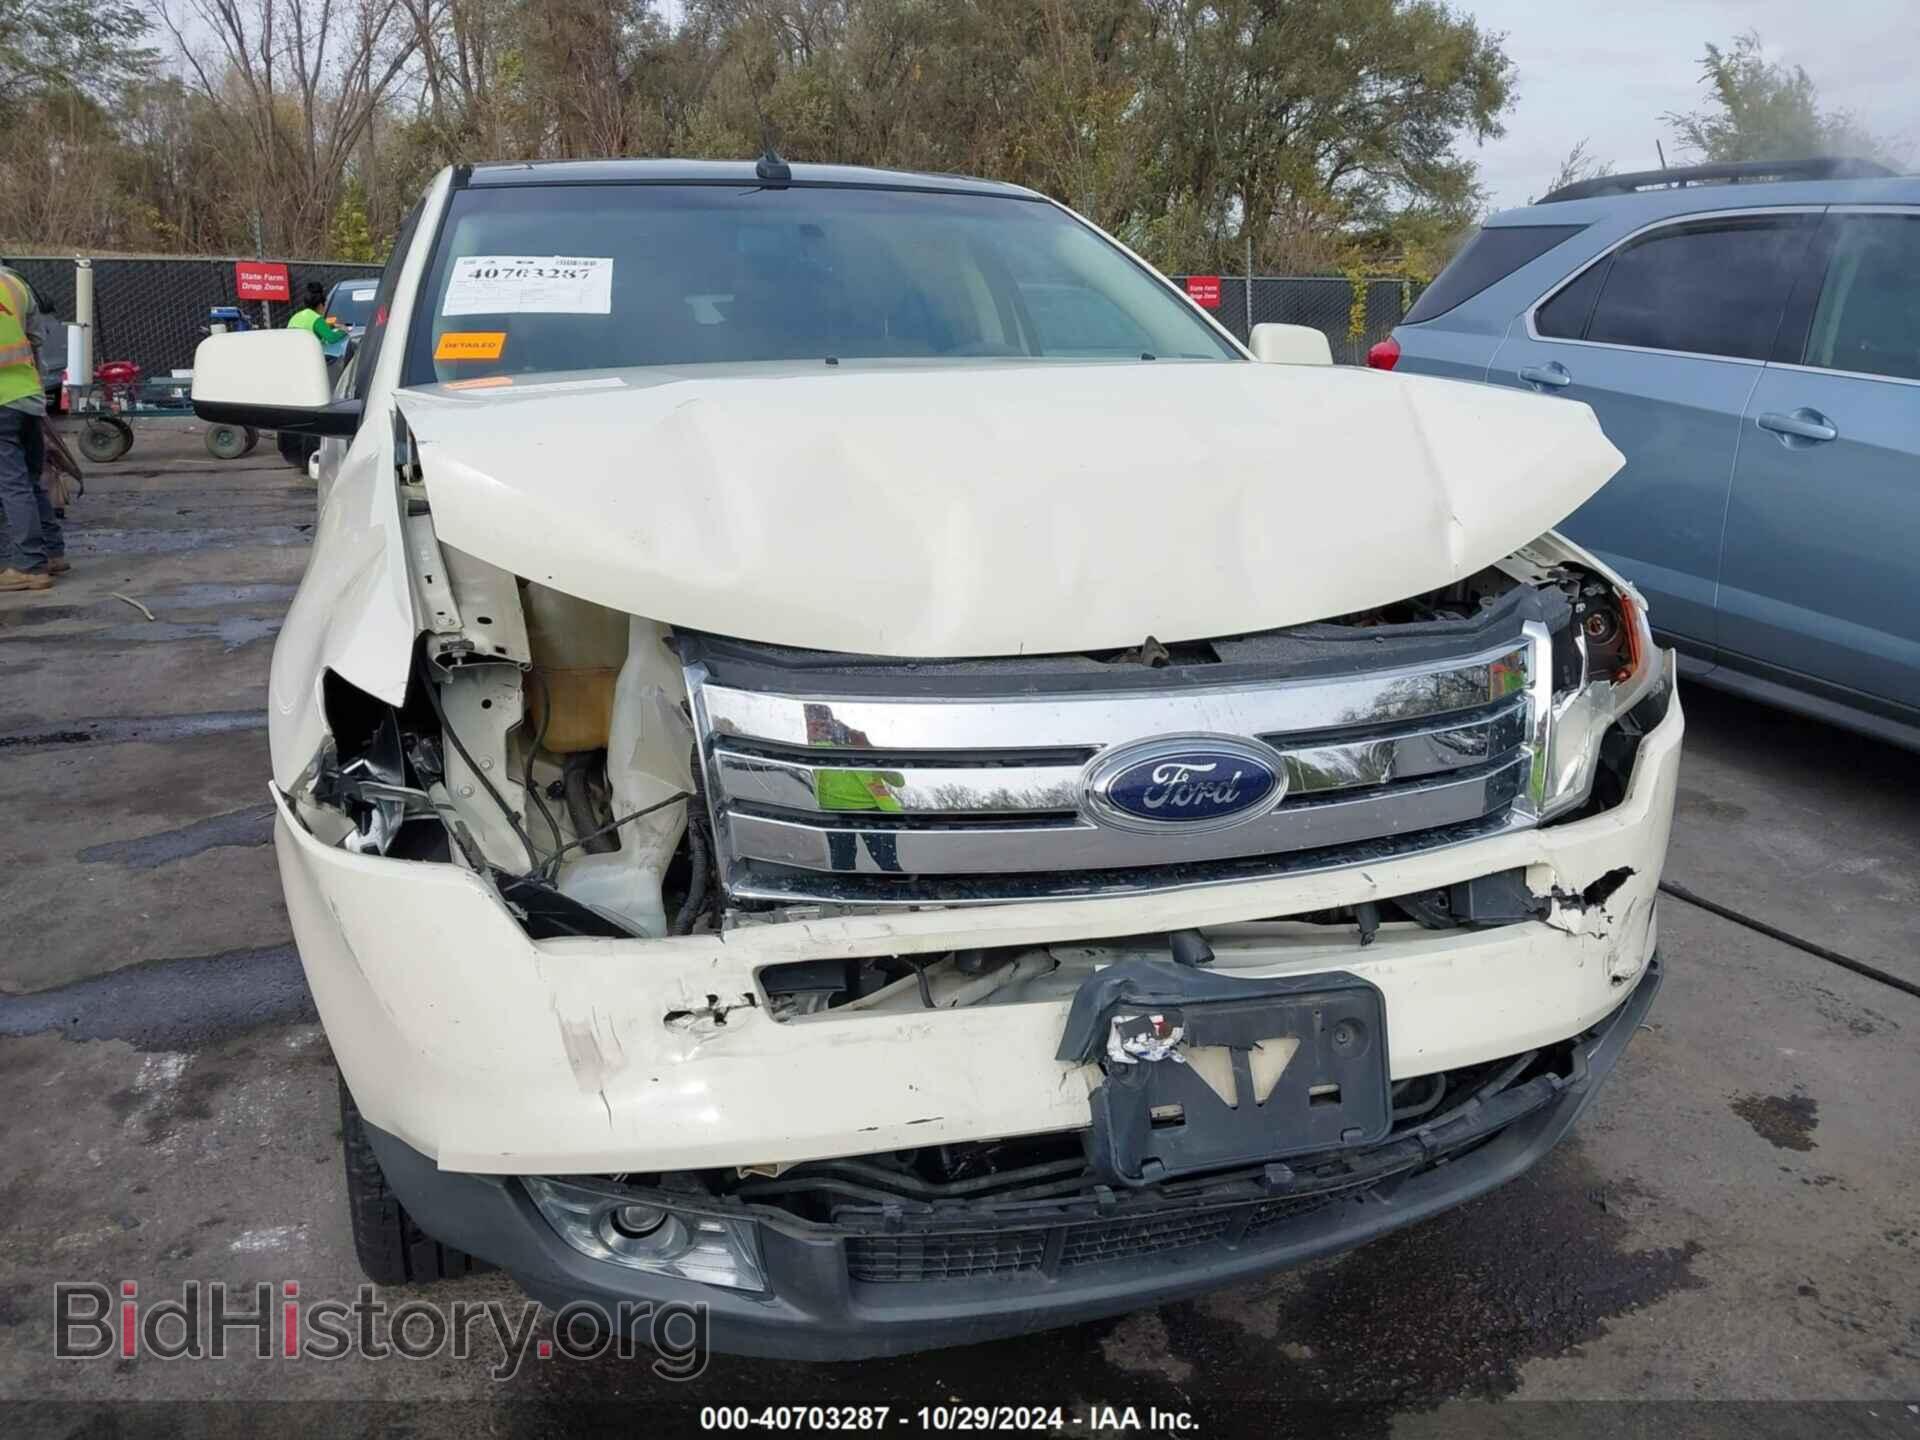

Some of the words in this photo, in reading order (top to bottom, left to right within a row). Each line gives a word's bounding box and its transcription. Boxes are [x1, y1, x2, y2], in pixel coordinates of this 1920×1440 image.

[241, 272, 262, 280] State
[264, 272, 284, 281] Farm
[242, 282, 262, 291] Drop
[264, 282, 284, 290] Zone
[1143, 762, 1242, 809] Ford
